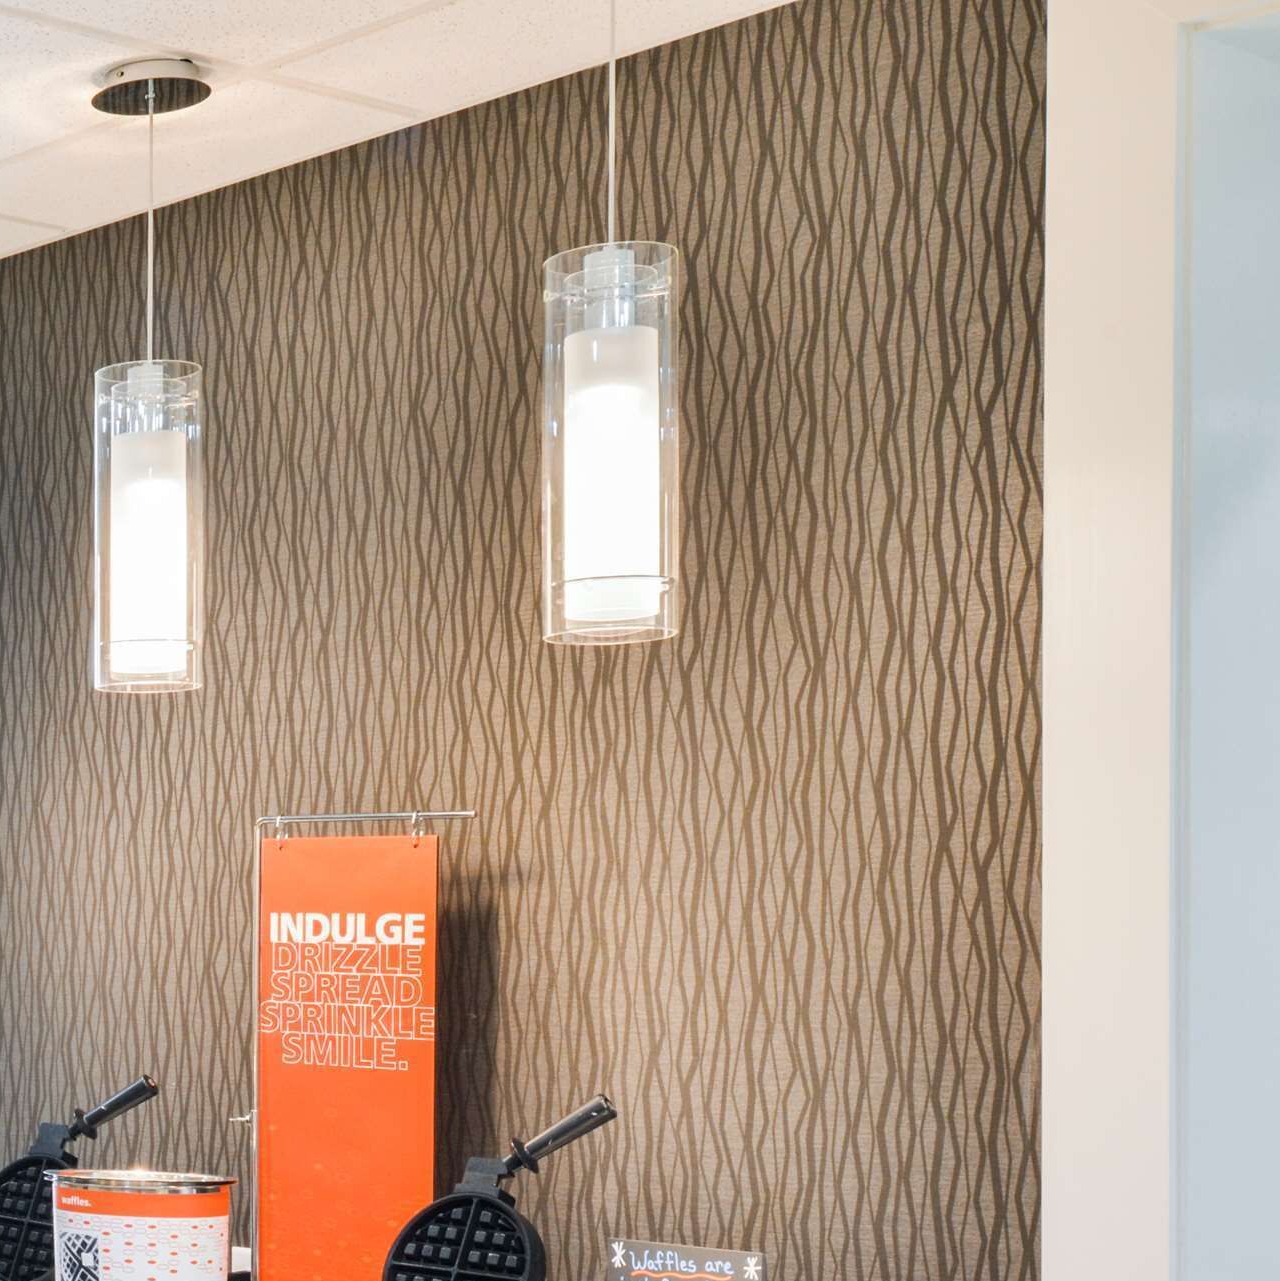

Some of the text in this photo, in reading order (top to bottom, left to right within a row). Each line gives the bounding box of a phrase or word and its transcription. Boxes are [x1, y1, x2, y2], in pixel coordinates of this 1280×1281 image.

[270, 912, 425, 945] INDULGE
[272, 941, 422, 977] DRIZZLE
[270, 970, 423, 1008] SPREAD
[258, 1000, 435, 1040] SPRINKLE
[282, 1031, 409, 1071] SMILE.
[629, 1250, 735, 1275] Waffles are
